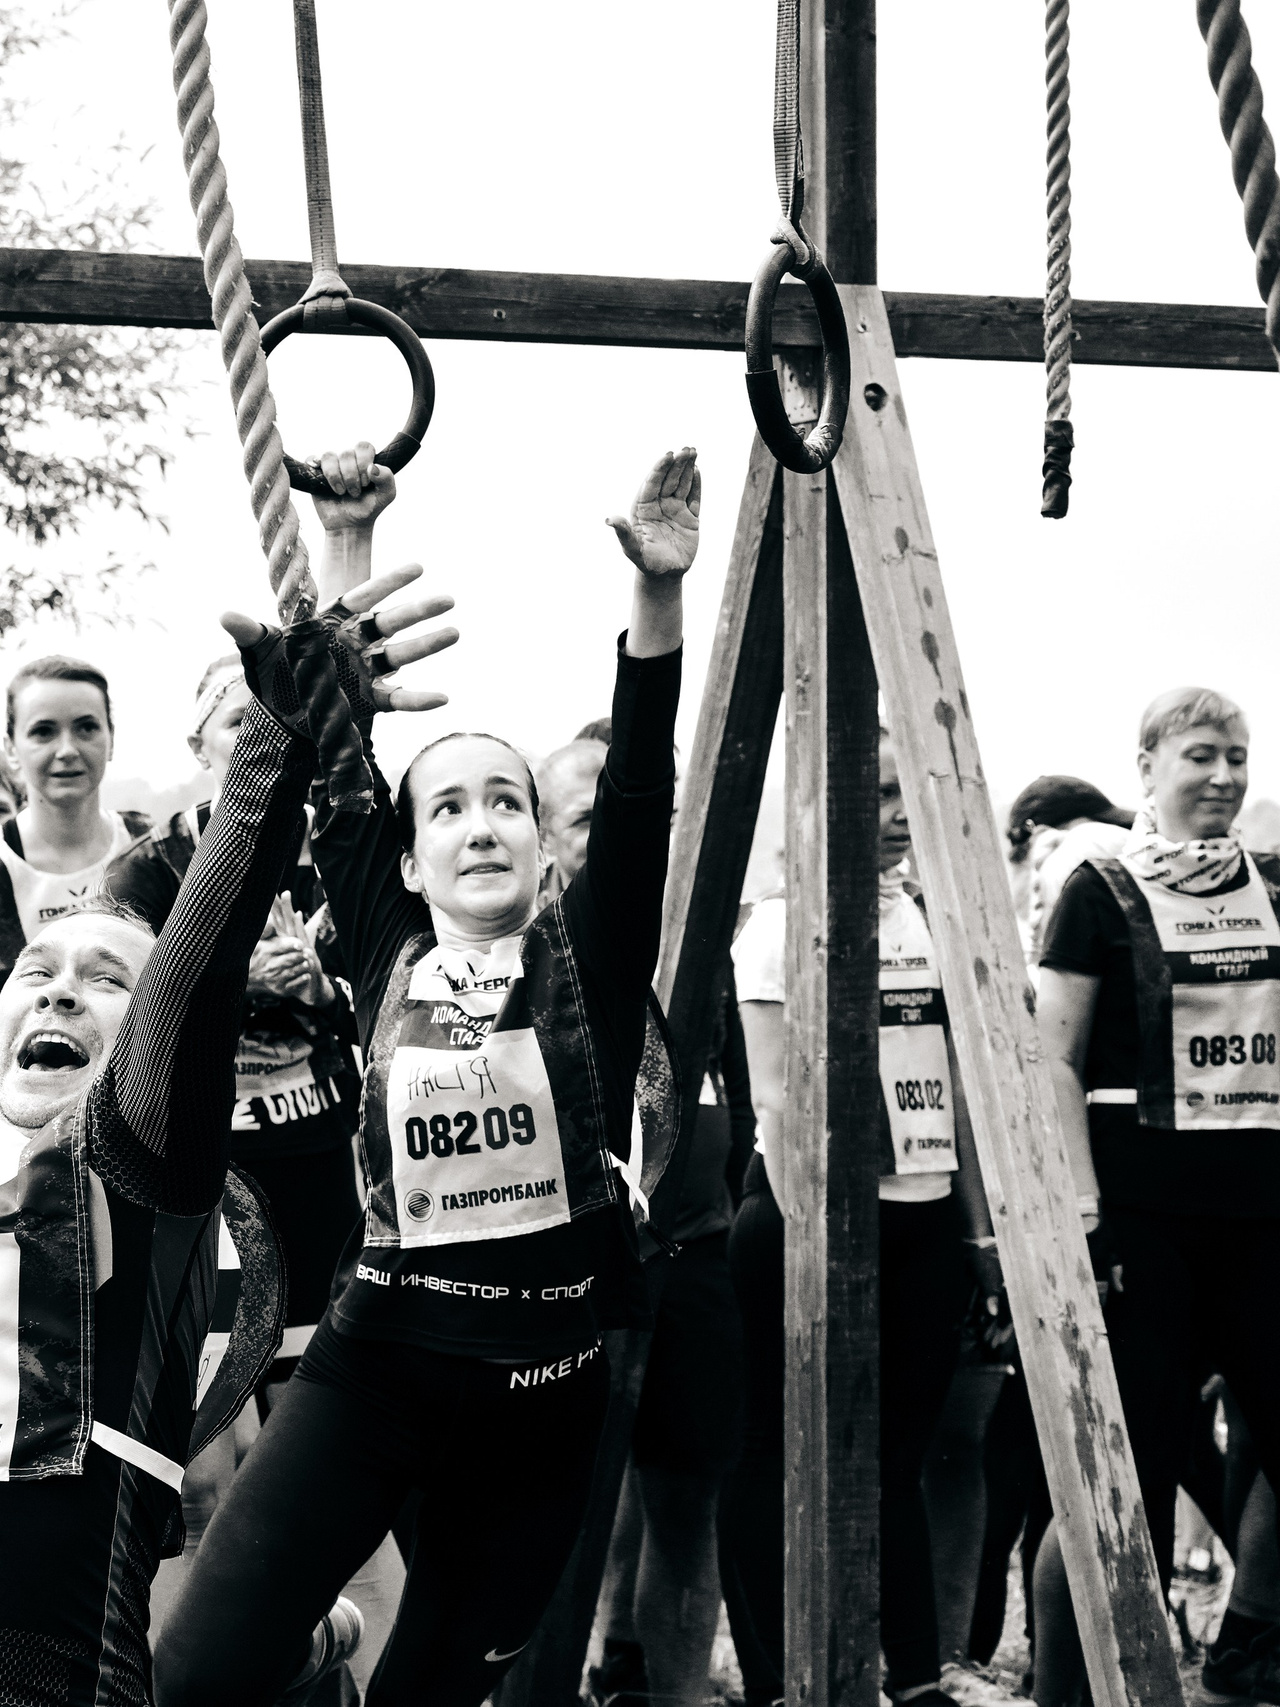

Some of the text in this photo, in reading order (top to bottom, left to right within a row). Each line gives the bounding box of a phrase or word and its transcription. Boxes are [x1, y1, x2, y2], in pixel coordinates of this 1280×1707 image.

[1189, 1033, 1276, 1068] 08308
[895, 1080, 945, 1111] 08302
[405, 1103, 537, 1160] 08209
[441, 1178, 559, 1211] ГАЗПРОМБАНК
[355, 1263, 392, 1287] ВАШ
[400, 1273, 510, 1300] ИНВЕСТОР
[541, 1275, 596, 1301] СПОРТ
[509, 1356, 573, 1390] NIKE
